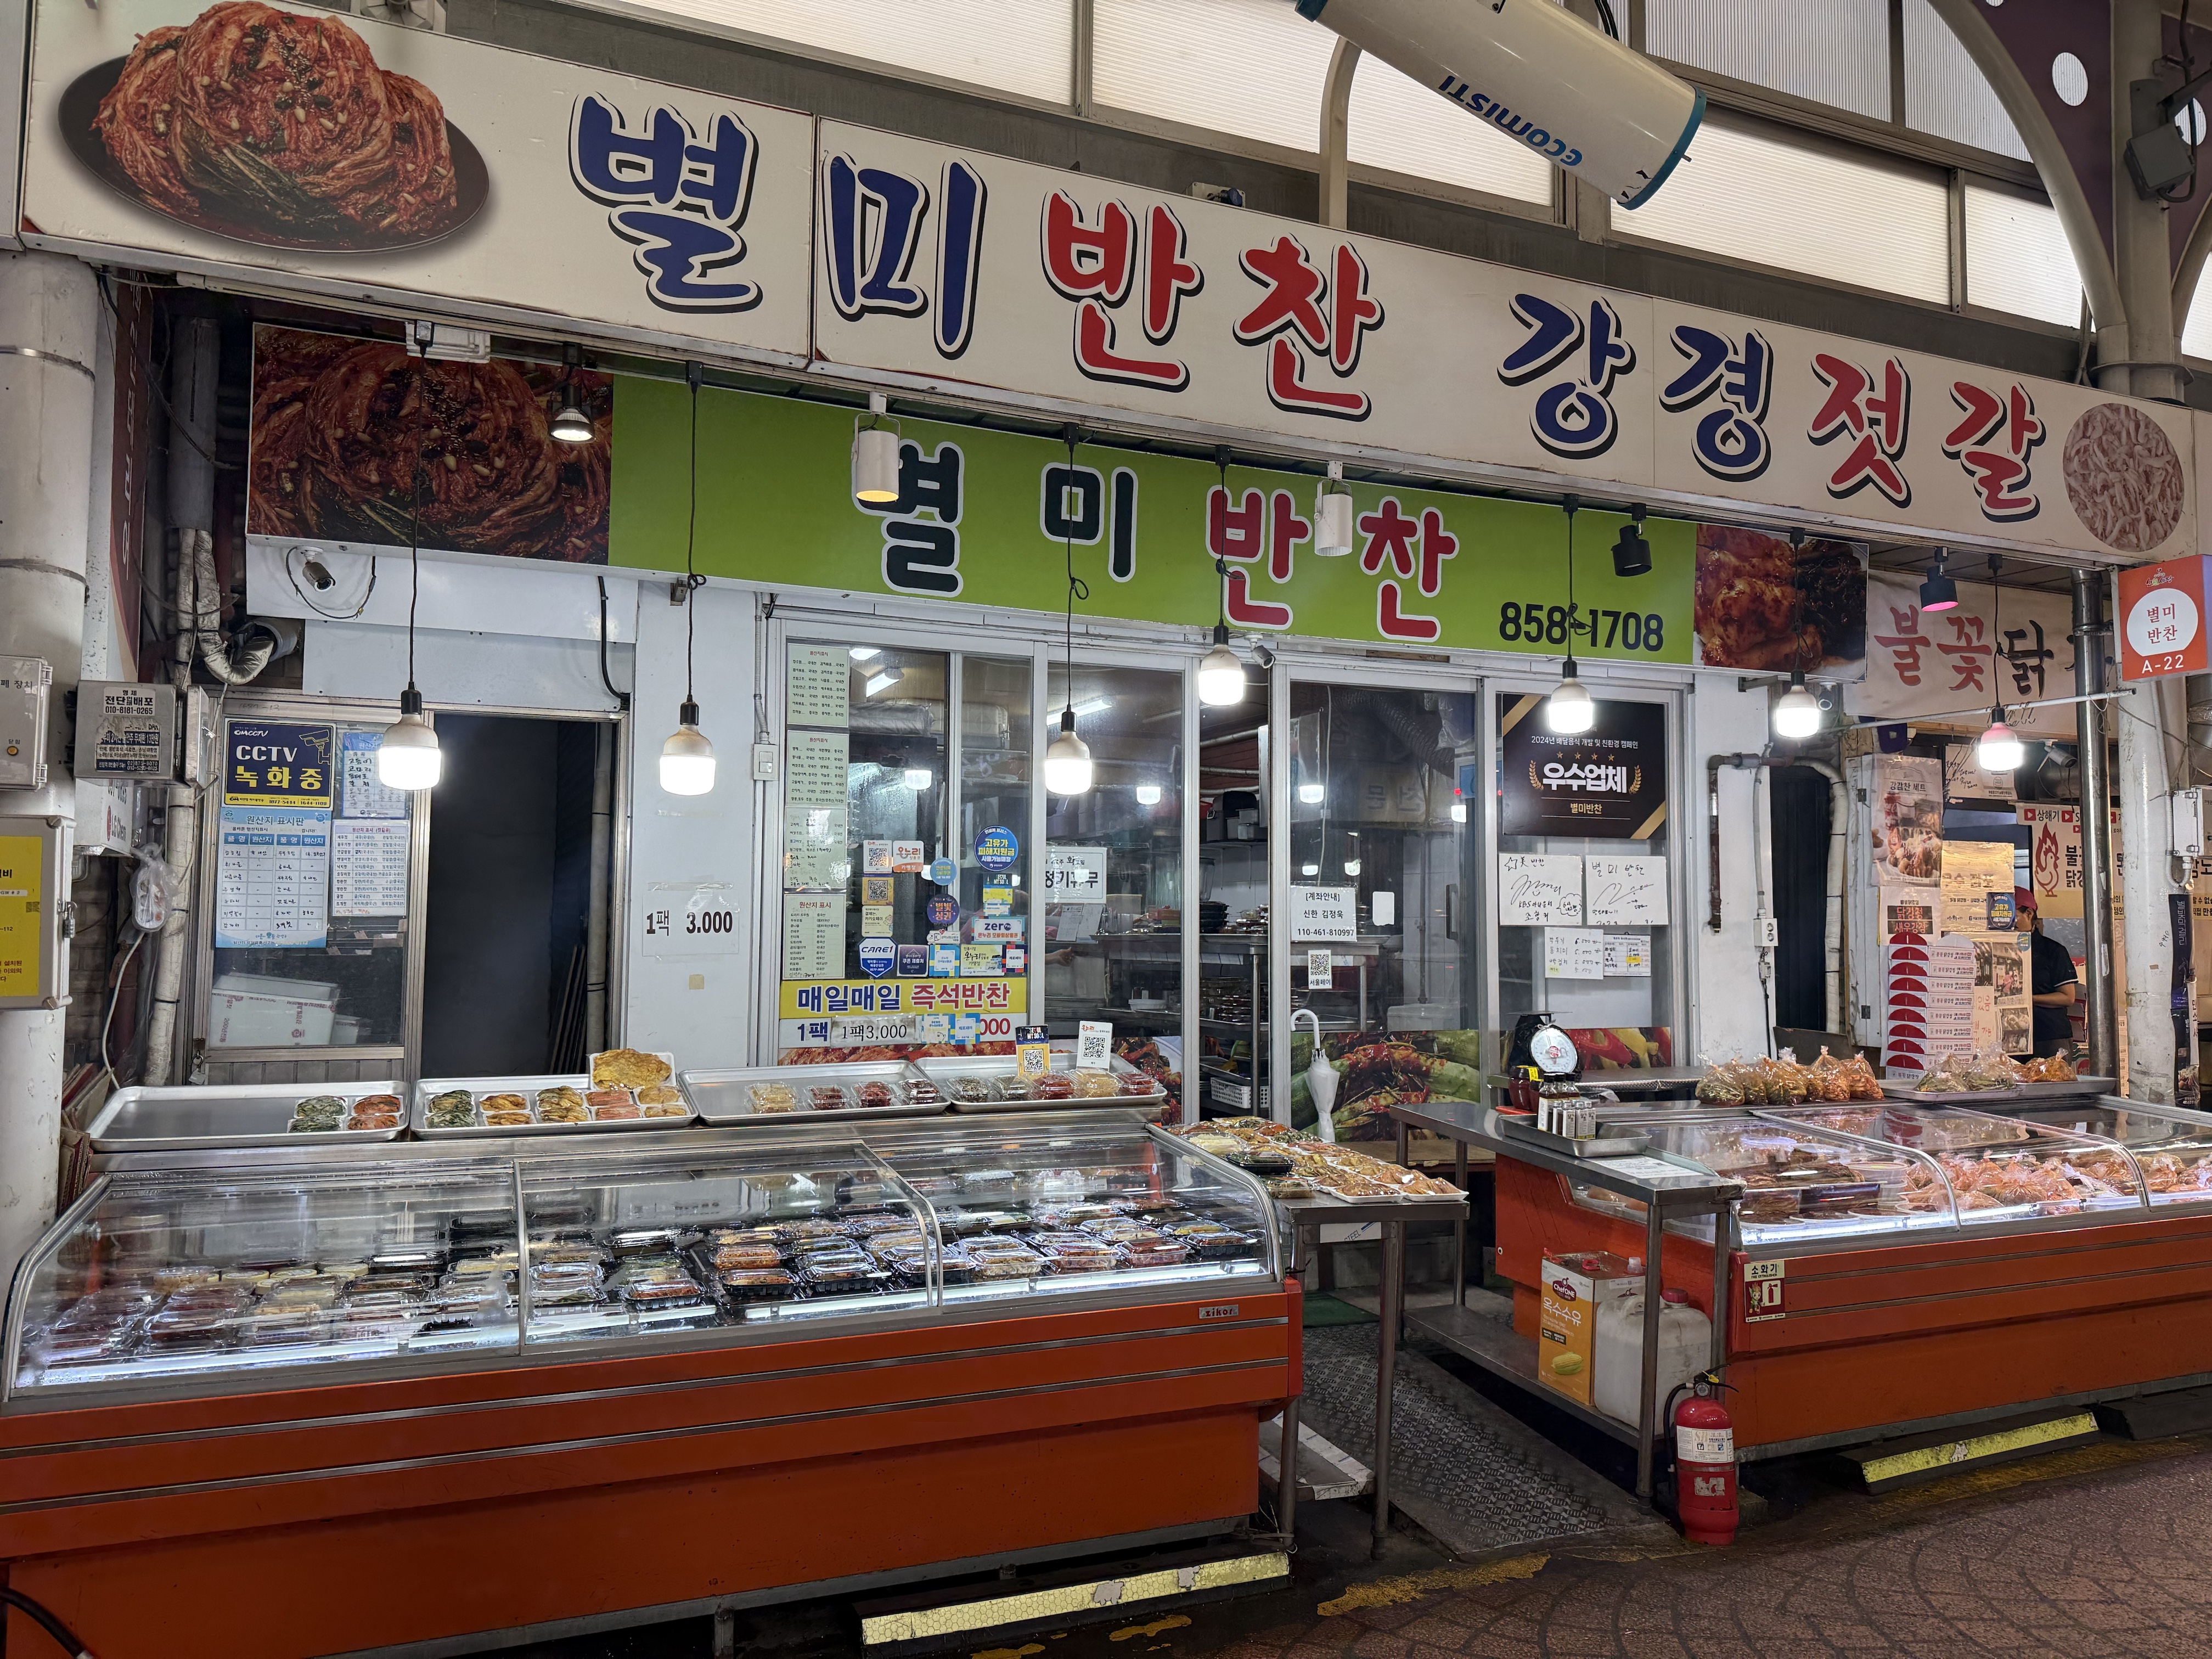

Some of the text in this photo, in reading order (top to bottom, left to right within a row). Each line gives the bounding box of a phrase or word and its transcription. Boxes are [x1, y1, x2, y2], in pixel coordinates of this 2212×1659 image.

[2147, 603, 2176, 623] 별미
[1499, 601, 1663, 651] 858-1708
[2147, 625, 2178, 644] 반찬
[2142, 654, 2184, 674] A-22
[14, 681, 33, 689] 장치
[105, 706, 153, 715] 010-8181-0265
[1531, 735, 1555, 745] 2024년
[1581, 738, 1593, 746] 개발
[1594, 739, 1601, 747] 및
[1602, 740, 1620, 748] 친환경
[236, 745, 297, 762] CCTV
[1543, 762, 1627, 794] 우수업체
[1913, 783, 1927, 792] 세트
[1570, 803, 1602, 814] 별미반찬
[246, 815, 304, 826] 원산지 표시판
[2037, 809, 2059, 823] 상해기
[984, 838, 1009, 847] 고유가
[896, 846, 921, 859] 온누리
[978, 847, 1015, 857] 피해지원금
[1305, 892, 1340, 902] [계좌안내]
[935, 902, 952, 912] 별빛
[935, 912, 952, 921] 상권
[1303, 909, 1343, 919] 신한 김정욱
[1896, 907, 1923, 920] 닭강정
[646, 910, 669, 936] 1팩
[1895, 921, 1927, 933] 새우강정
[1297, 928, 1354, 936] 110-461-810997
[862, 945, 894, 953] CARE1
[964, 951, 981, 961] 온누리
[797, 982, 1011, 1013] 매일매일 즉석반찬
[797, 1022, 829, 1042] 1팩
[1751, 1263, 1777, 1275] 소화기
[1543, 1297, 1581, 1326] 옥수수유
